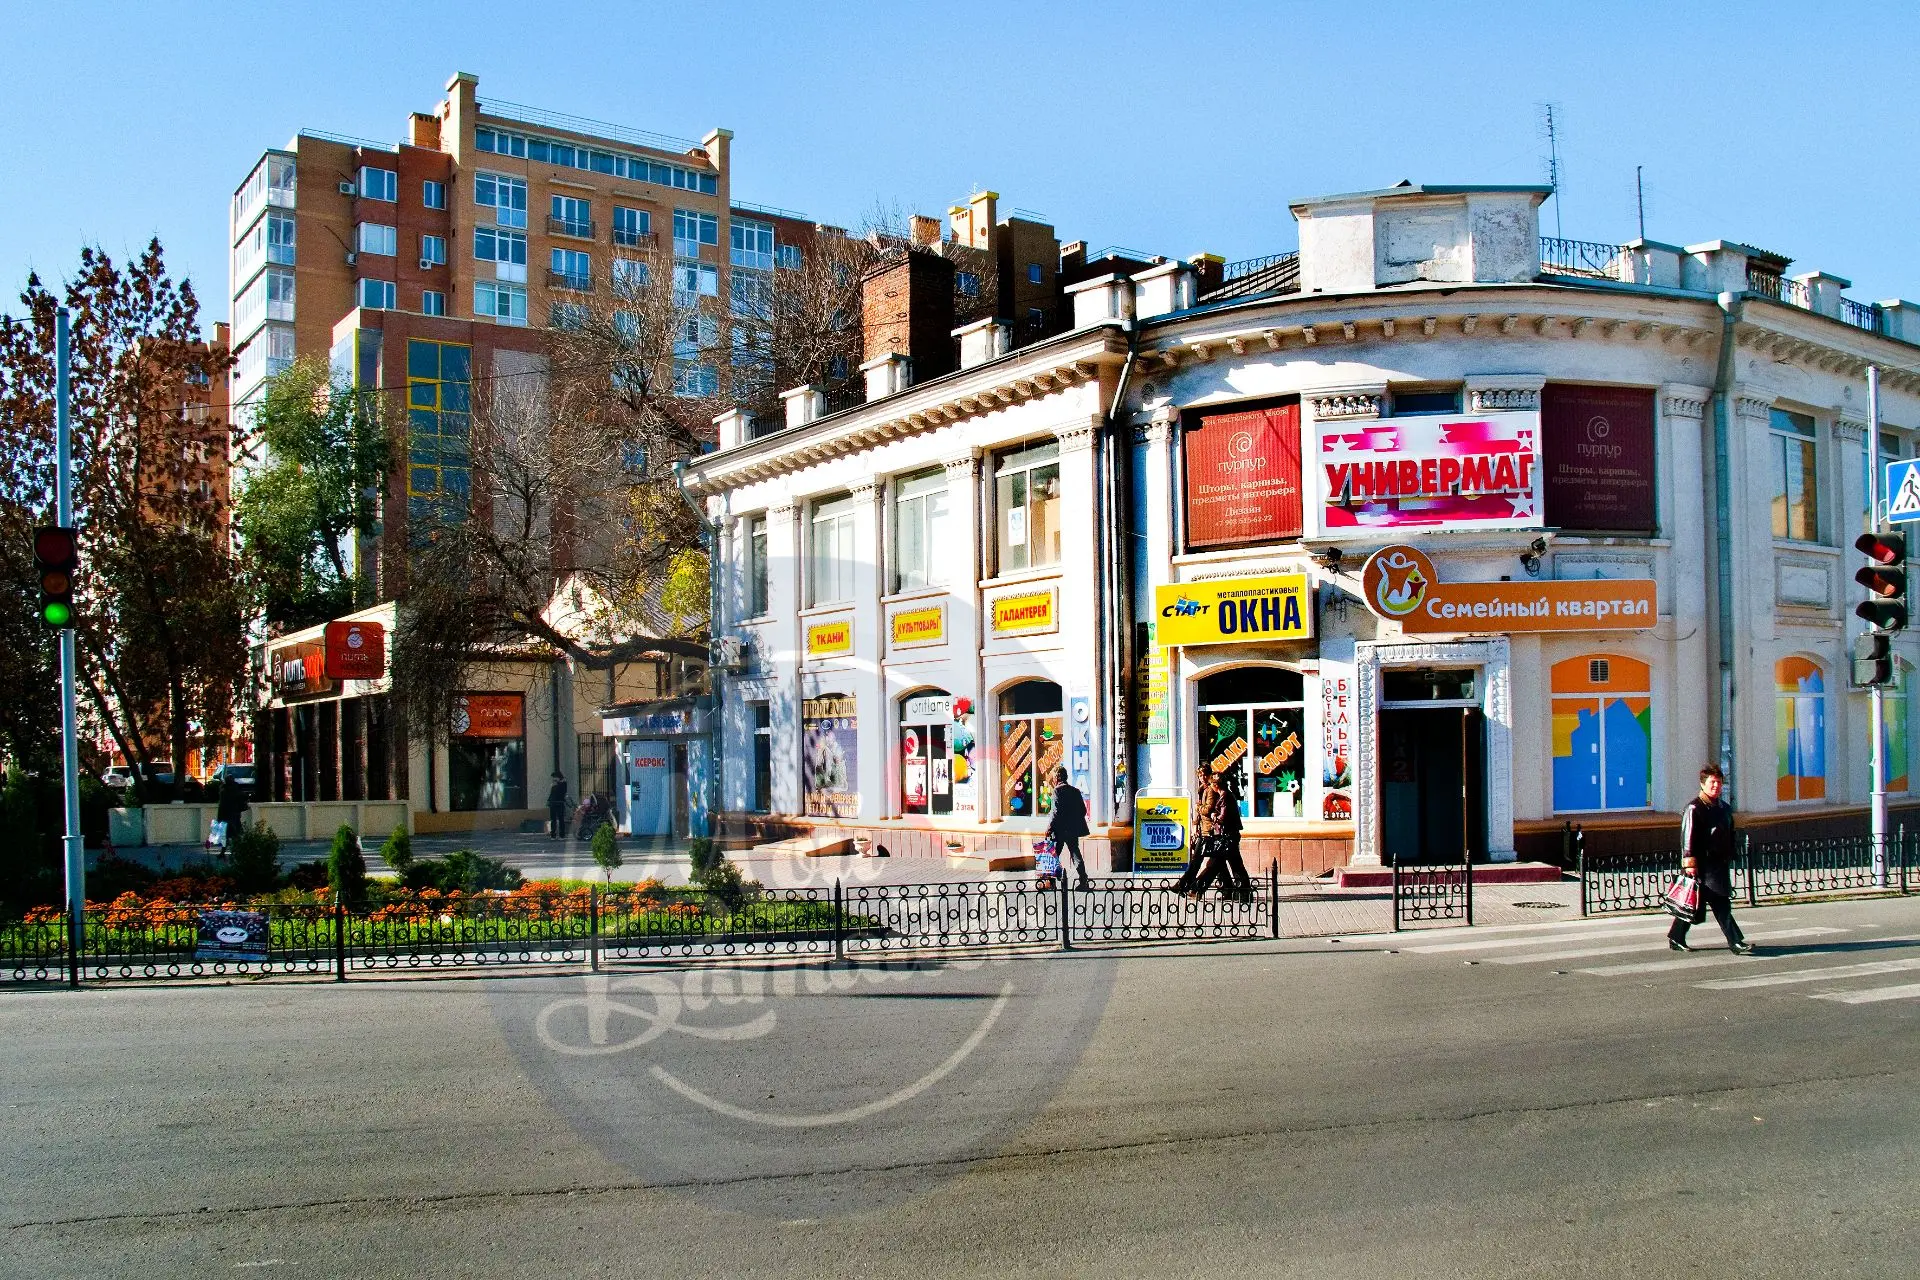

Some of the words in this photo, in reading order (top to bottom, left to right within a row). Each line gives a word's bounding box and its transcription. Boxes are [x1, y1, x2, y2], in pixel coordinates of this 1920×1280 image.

[1577, 443, 1622, 458] пурпур
[1217, 457, 1267, 475] пурпур
[1325, 454, 1534, 498] УНИВЕРМАГ
[1199, 484, 1238, 495] Шторы,
[1241, 477, 1288, 489] карнизы,
[1192, 493, 1240, 505] предметы
[1243, 486, 1296, 499] интерьера
[1225, 505, 1261, 517] Дизайн
[1217, 586, 1299, 599] металлопластиковые
[999, 604, 1047, 622] ГАЛАНТЕРЕЯ
[1162, 604, 1211, 618] СТАРТ
[1218, 595, 1302, 634] ОКНА
[1426, 596, 1550, 619] Семейный
[1556, 598, 1649, 620] квартал
[816, 631, 844, 646] ТКАНИ
[1325, 679, 1333, 758] ПОСТЕЛЬНОЕ
[1337, 678, 1348, 757] БЕЛЬЕ
[1073, 701, 1090, 796] ОКНА
[1258, 731, 1302, 775] СПОРТ
[634, 757, 666, 768] КСЕРОКС
[1324, 810, 1329, 819] 2
[1331, 811, 1350, 819] этаж
[1146, 826, 1172, 836] ОКНА
[1151, 835, 1177, 845] ДВЕРИ
